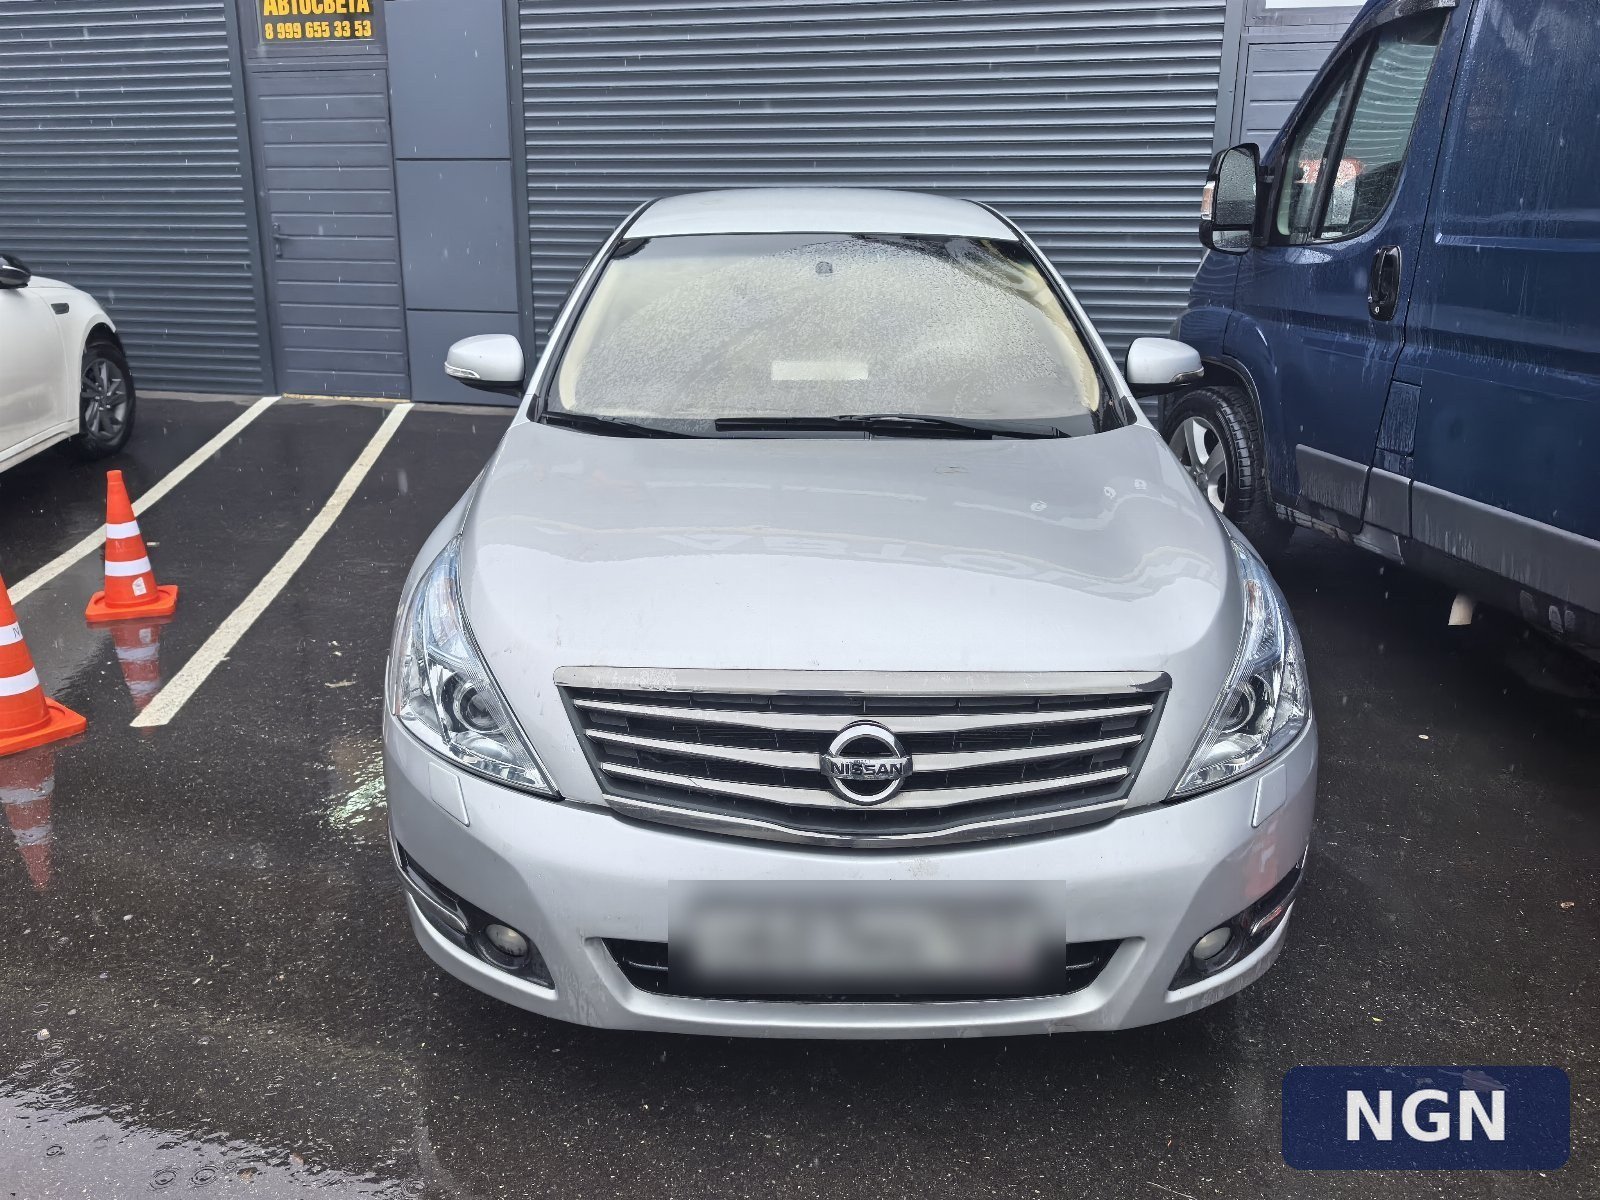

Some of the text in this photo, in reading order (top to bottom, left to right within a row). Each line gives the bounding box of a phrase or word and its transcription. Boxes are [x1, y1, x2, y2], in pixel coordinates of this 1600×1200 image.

[264, 20, 372, 39] 8 999 655 33 53
[829, 762, 903, 775] NISSAN
